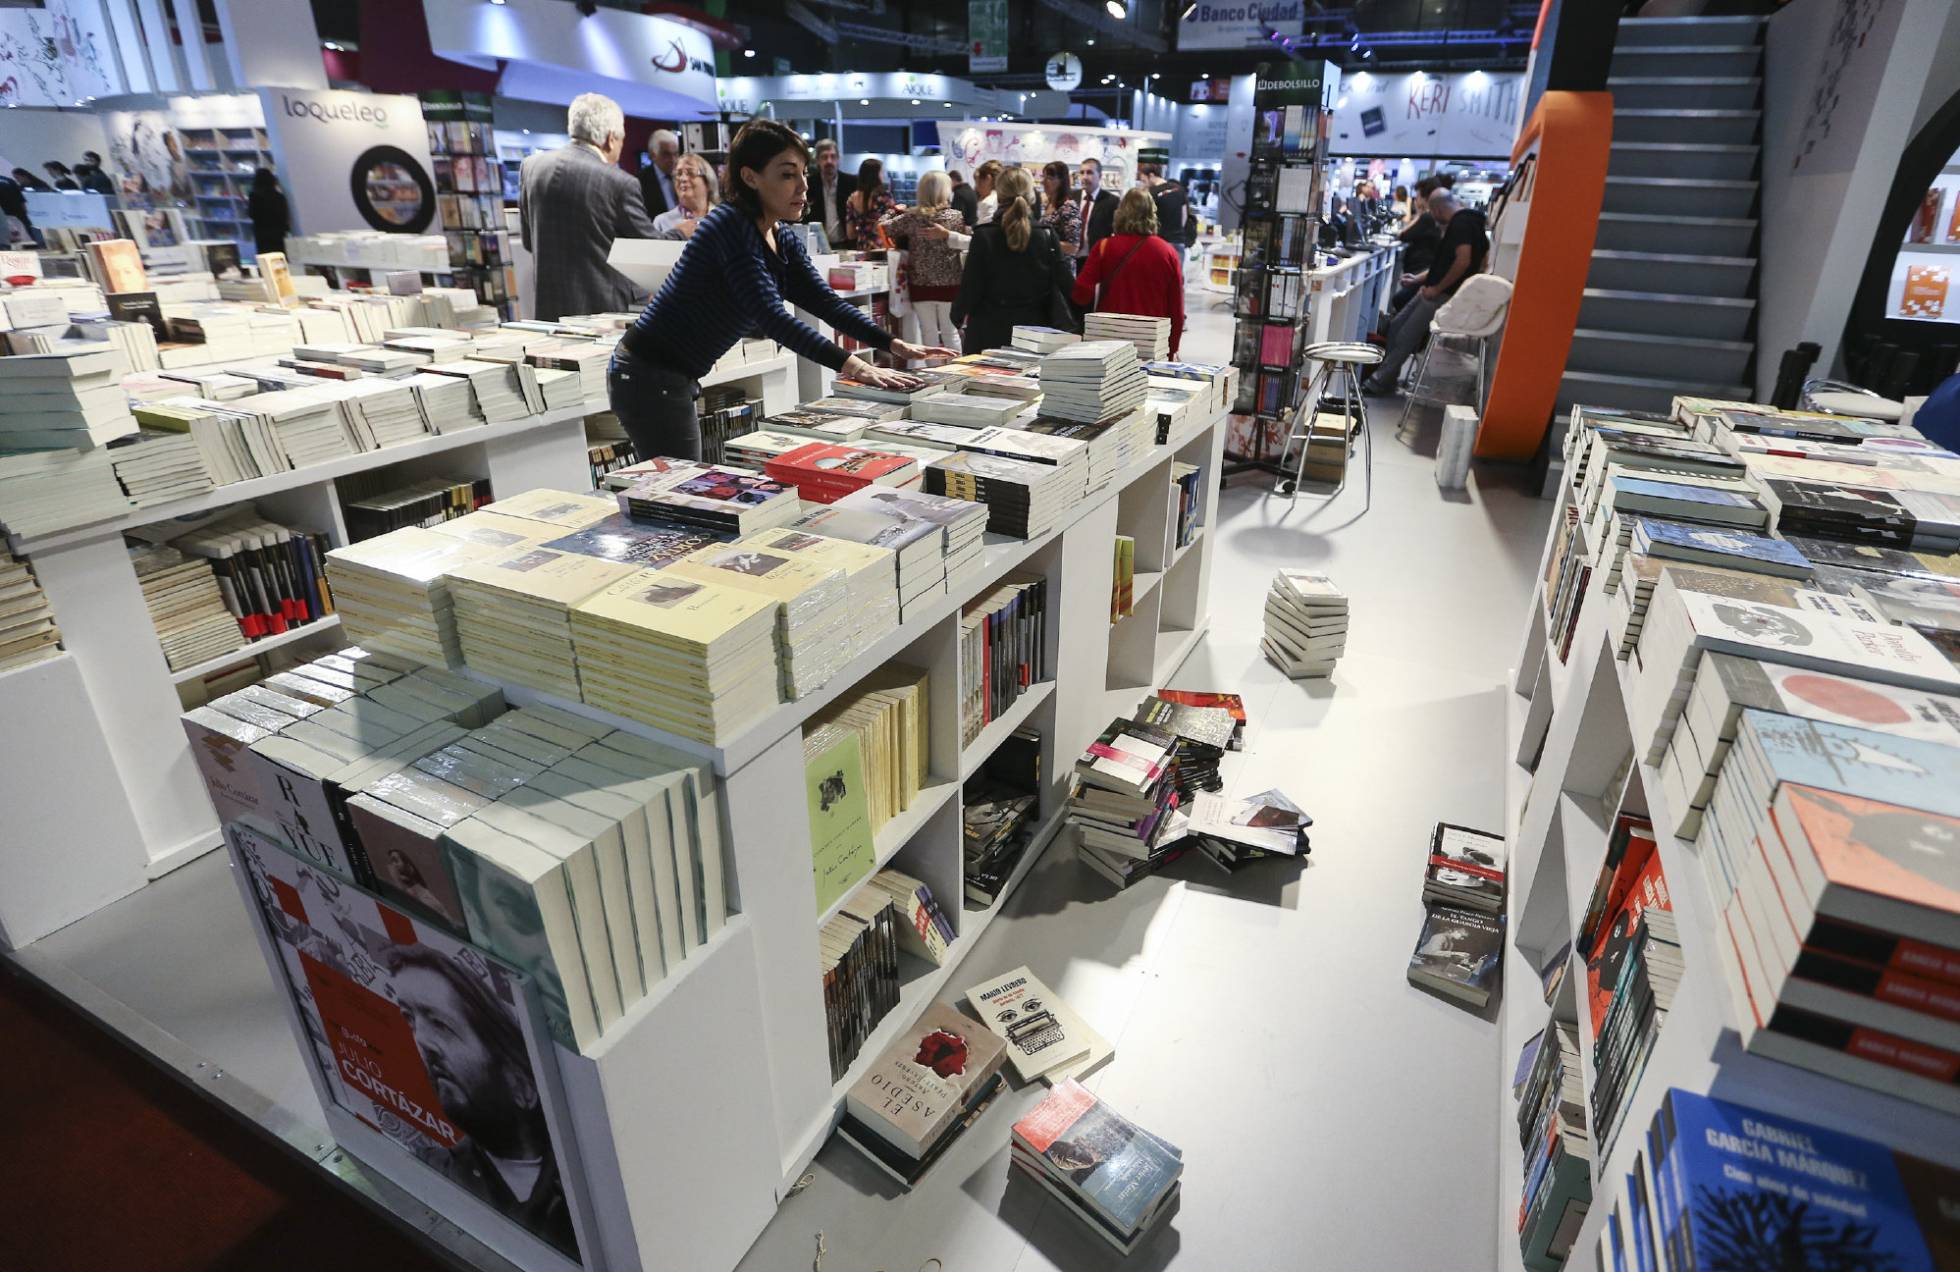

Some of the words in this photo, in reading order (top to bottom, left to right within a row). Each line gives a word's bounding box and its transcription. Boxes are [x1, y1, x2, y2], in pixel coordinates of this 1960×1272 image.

[1201, 5, 1246, 22] Banco
[1248, 1, 1298, 21] Ciudad
[1267, 78, 1320, 89] DEBOLSILLO
[282, 95, 388, 123] loqueleo
[1406, 81, 1450, 120] KERI
[1459, 79, 1518, 126] SMITH
[980, 987, 1002, 1001] MARIO
[338, 1040, 383, 1078] JULIO
[342, 1059, 457, 1145] CORTÁZAR
[871, 1074, 936, 1118] ASEDIO
[880, 1096, 904, 1116] EL
[1741, 1118, 1817, 1155] GABRIEL
[1705, 1127, 1773, 1163] GARCÍA
[1776, 1147, 1869, 1191] MÁRQUEZ
[1723, 1164, 1753, 1185] Cien
[1755, 1173, 1789, 1195] años
[1791, 1180, 1809, 1201] de
[1811, 1187, 1868, 1218] soledad
